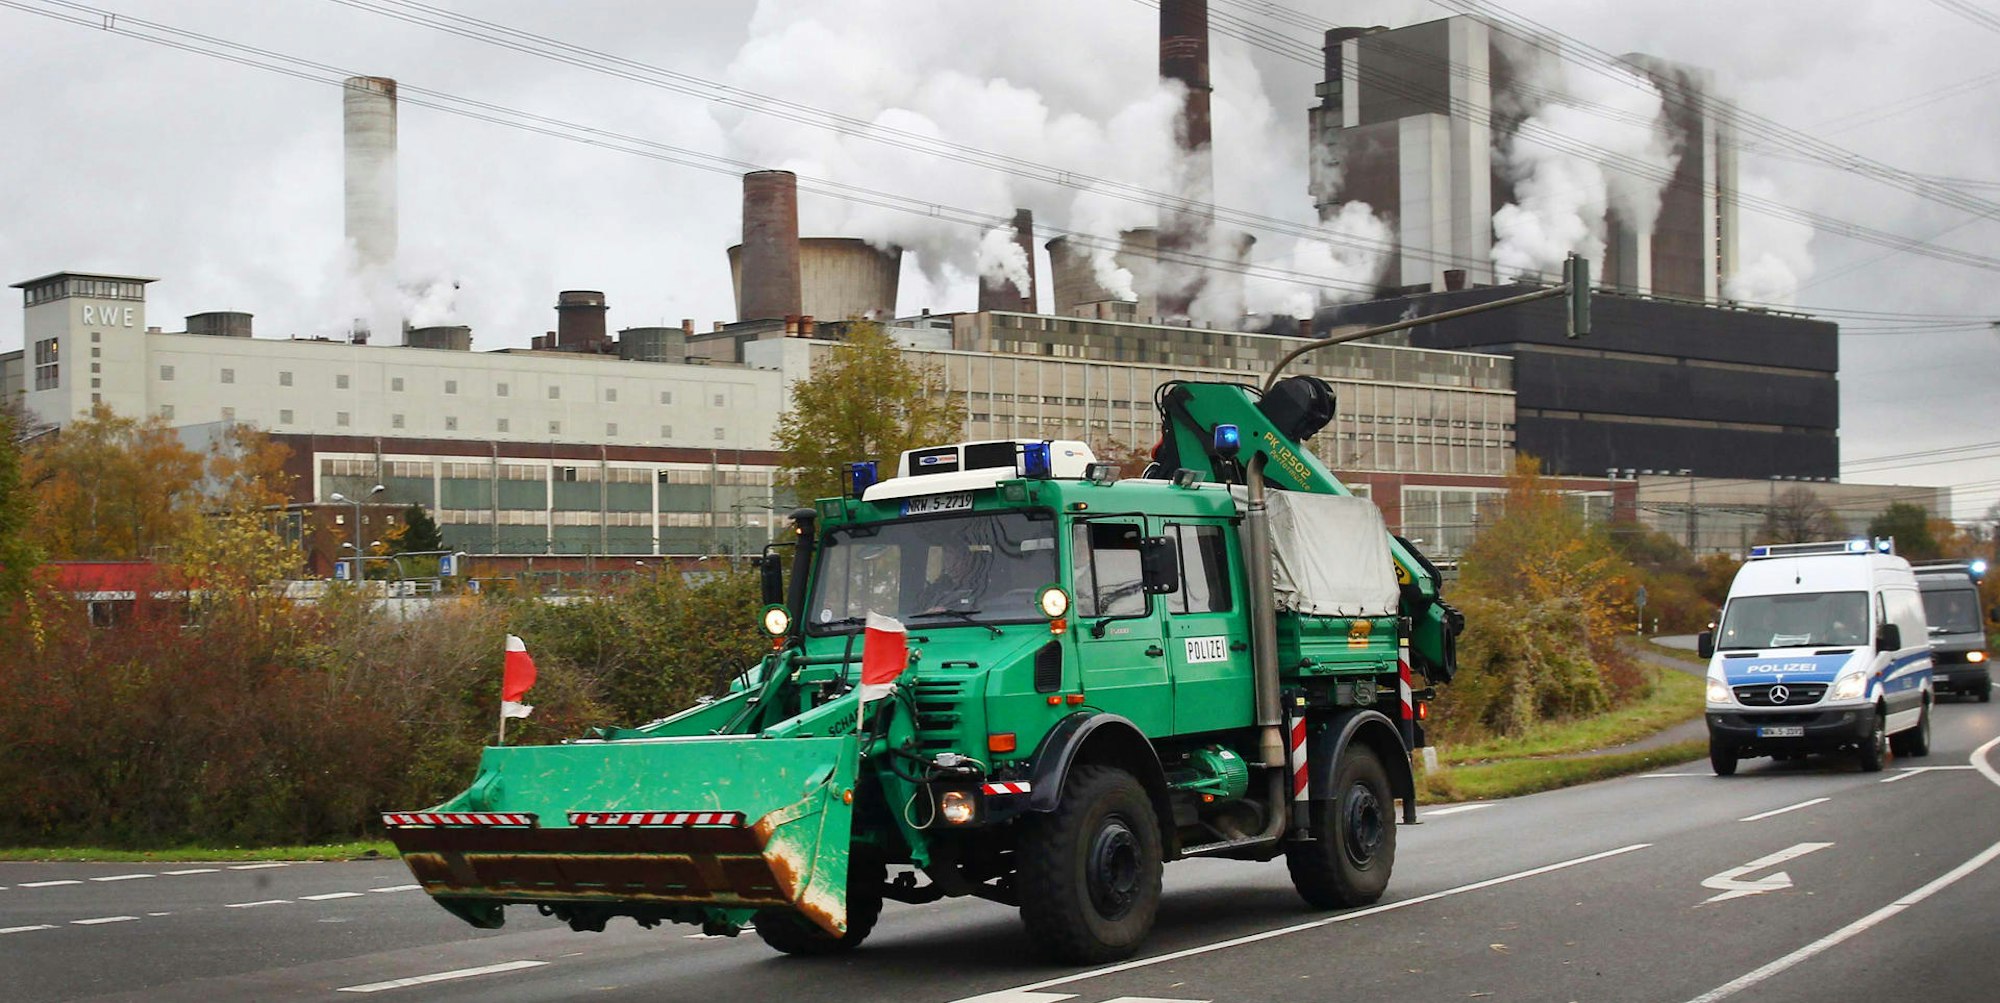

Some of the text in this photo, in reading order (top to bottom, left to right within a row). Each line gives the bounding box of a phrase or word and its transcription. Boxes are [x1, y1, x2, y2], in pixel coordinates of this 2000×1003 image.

[83, 305, 134, 327] RWE
[1263, 431, 1311, 480] PK 12502
[907, 494, 973, 513] NRW 5-2719
[1187, 640, 1226, 660] POLIZEI
[1746, 663, 1817, 674] POLIZEI
